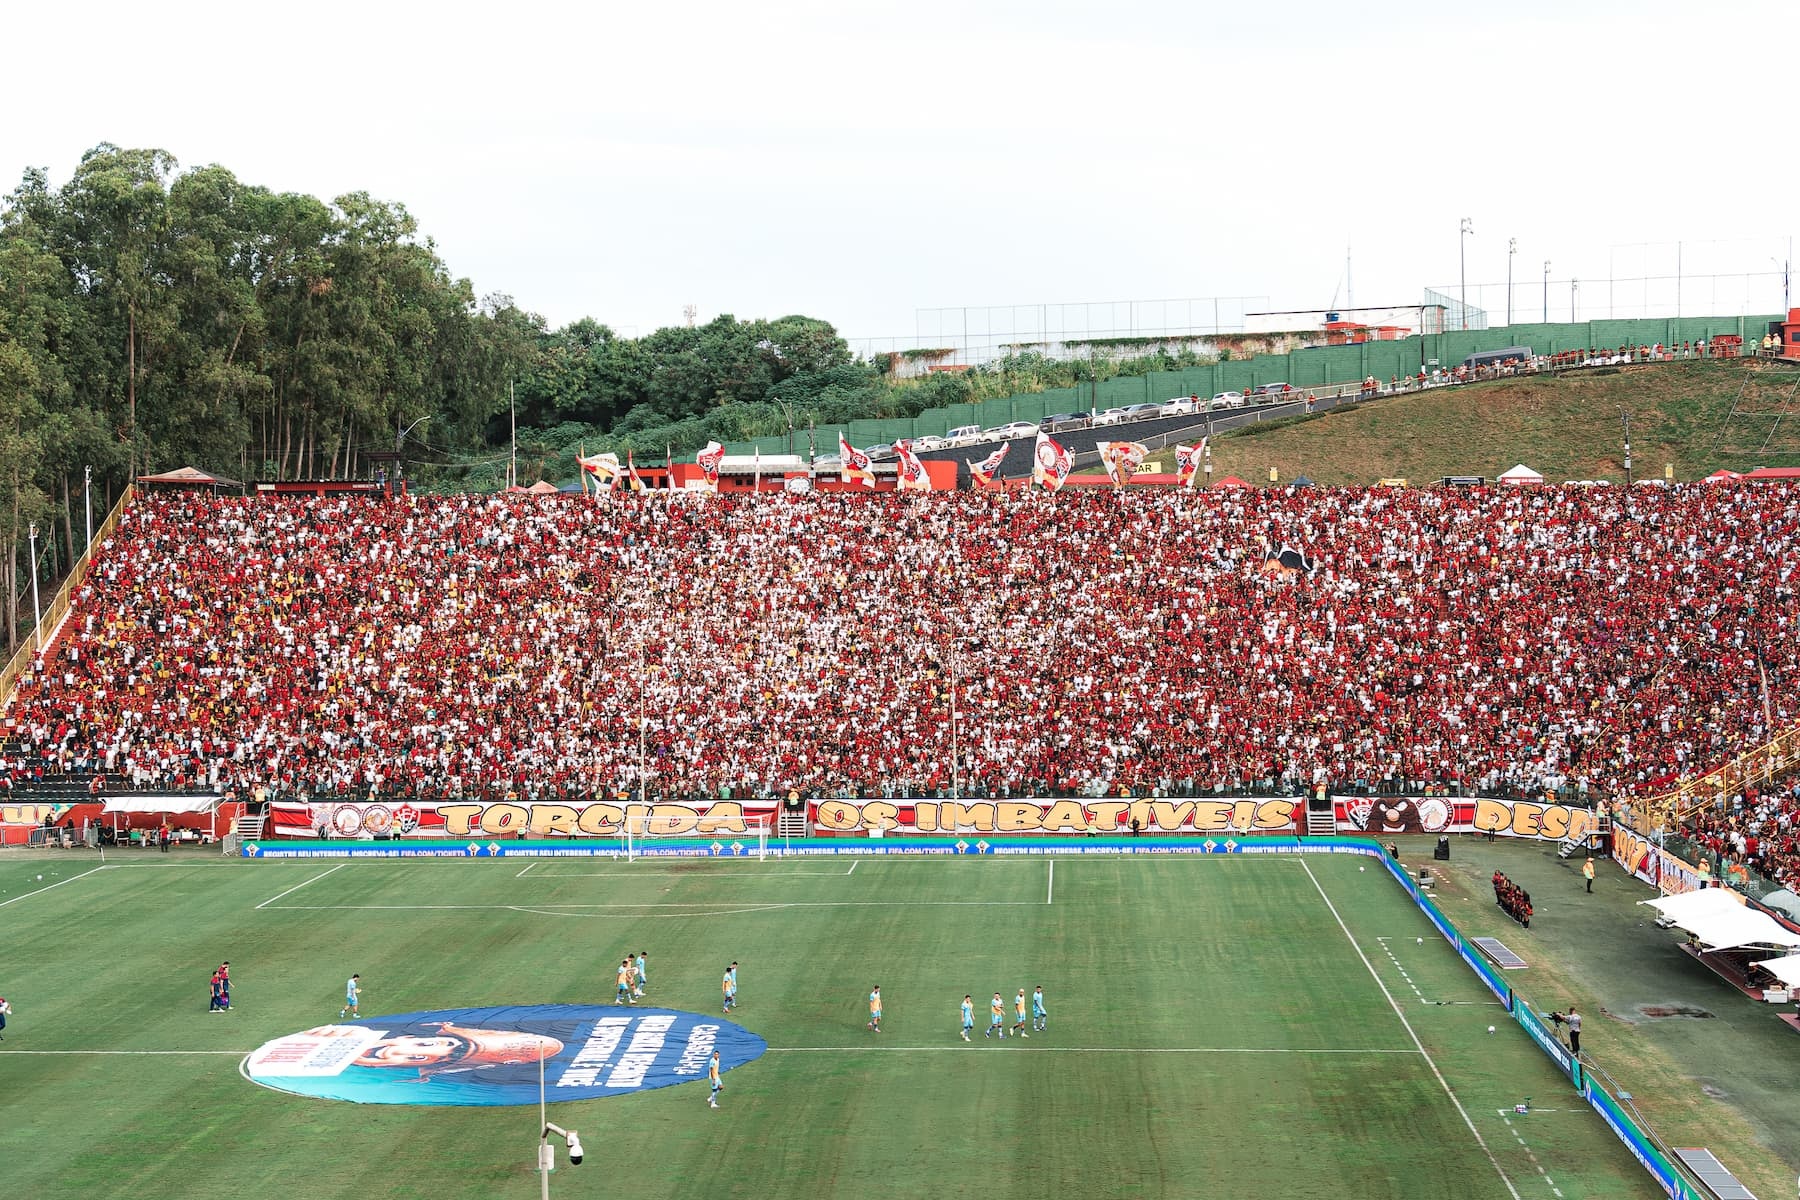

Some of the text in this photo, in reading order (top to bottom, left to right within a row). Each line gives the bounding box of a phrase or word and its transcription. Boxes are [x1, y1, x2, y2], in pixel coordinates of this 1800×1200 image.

[437, 802, 747, 835] TORCIDA
[818, 798, 1294, 831] OS IMBATÍVEIS
